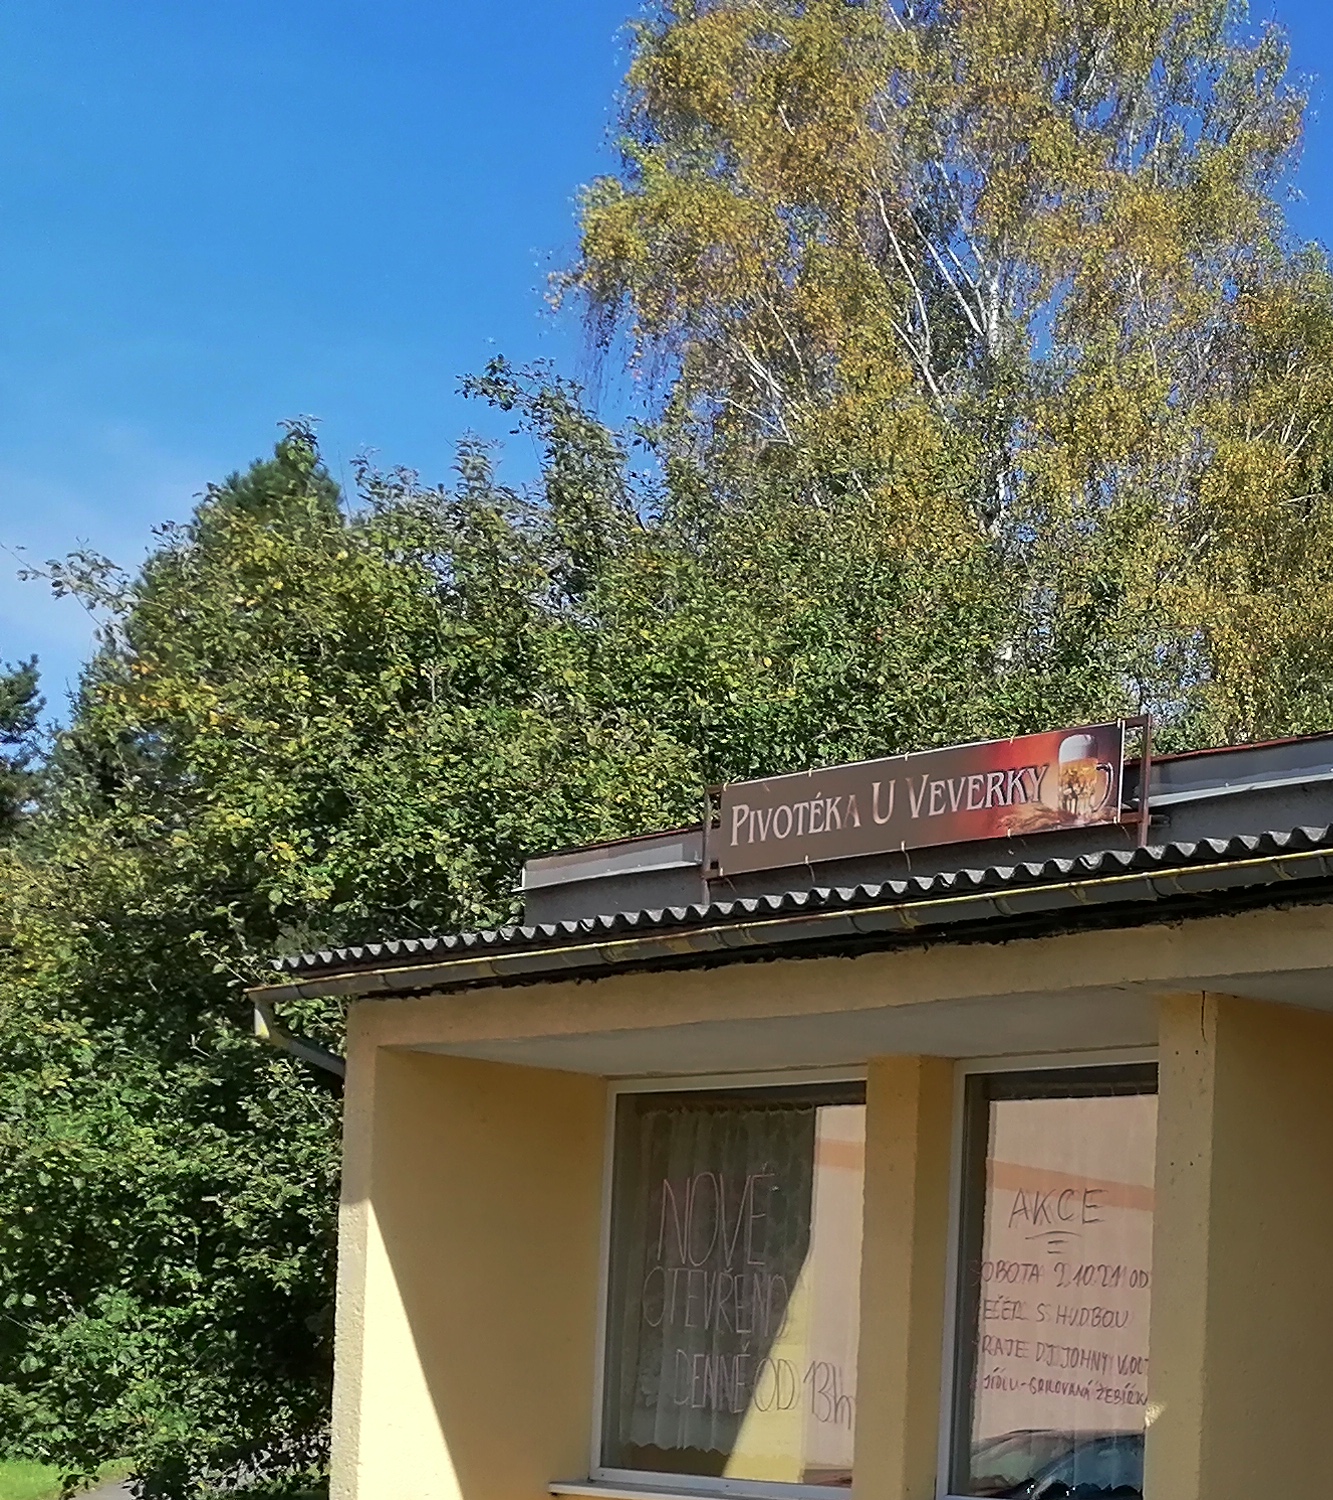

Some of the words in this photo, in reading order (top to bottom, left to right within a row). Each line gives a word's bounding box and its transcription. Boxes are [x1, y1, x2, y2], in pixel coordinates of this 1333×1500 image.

[730, 791, 860, 846] PIVOTÉKA
[872, 780, 895, 825] U
[906, 764, 1050, 820] VEVERKY
[1008, 1187, 1108, 1228] AKCE
[643, 1266, 789, 1339] OTEVŘENO
[1037, 1303, 1049, 1322] S
[674, 1342, 750, 1414] DENNĚ
[754, 1357, 795, 1412] OD
